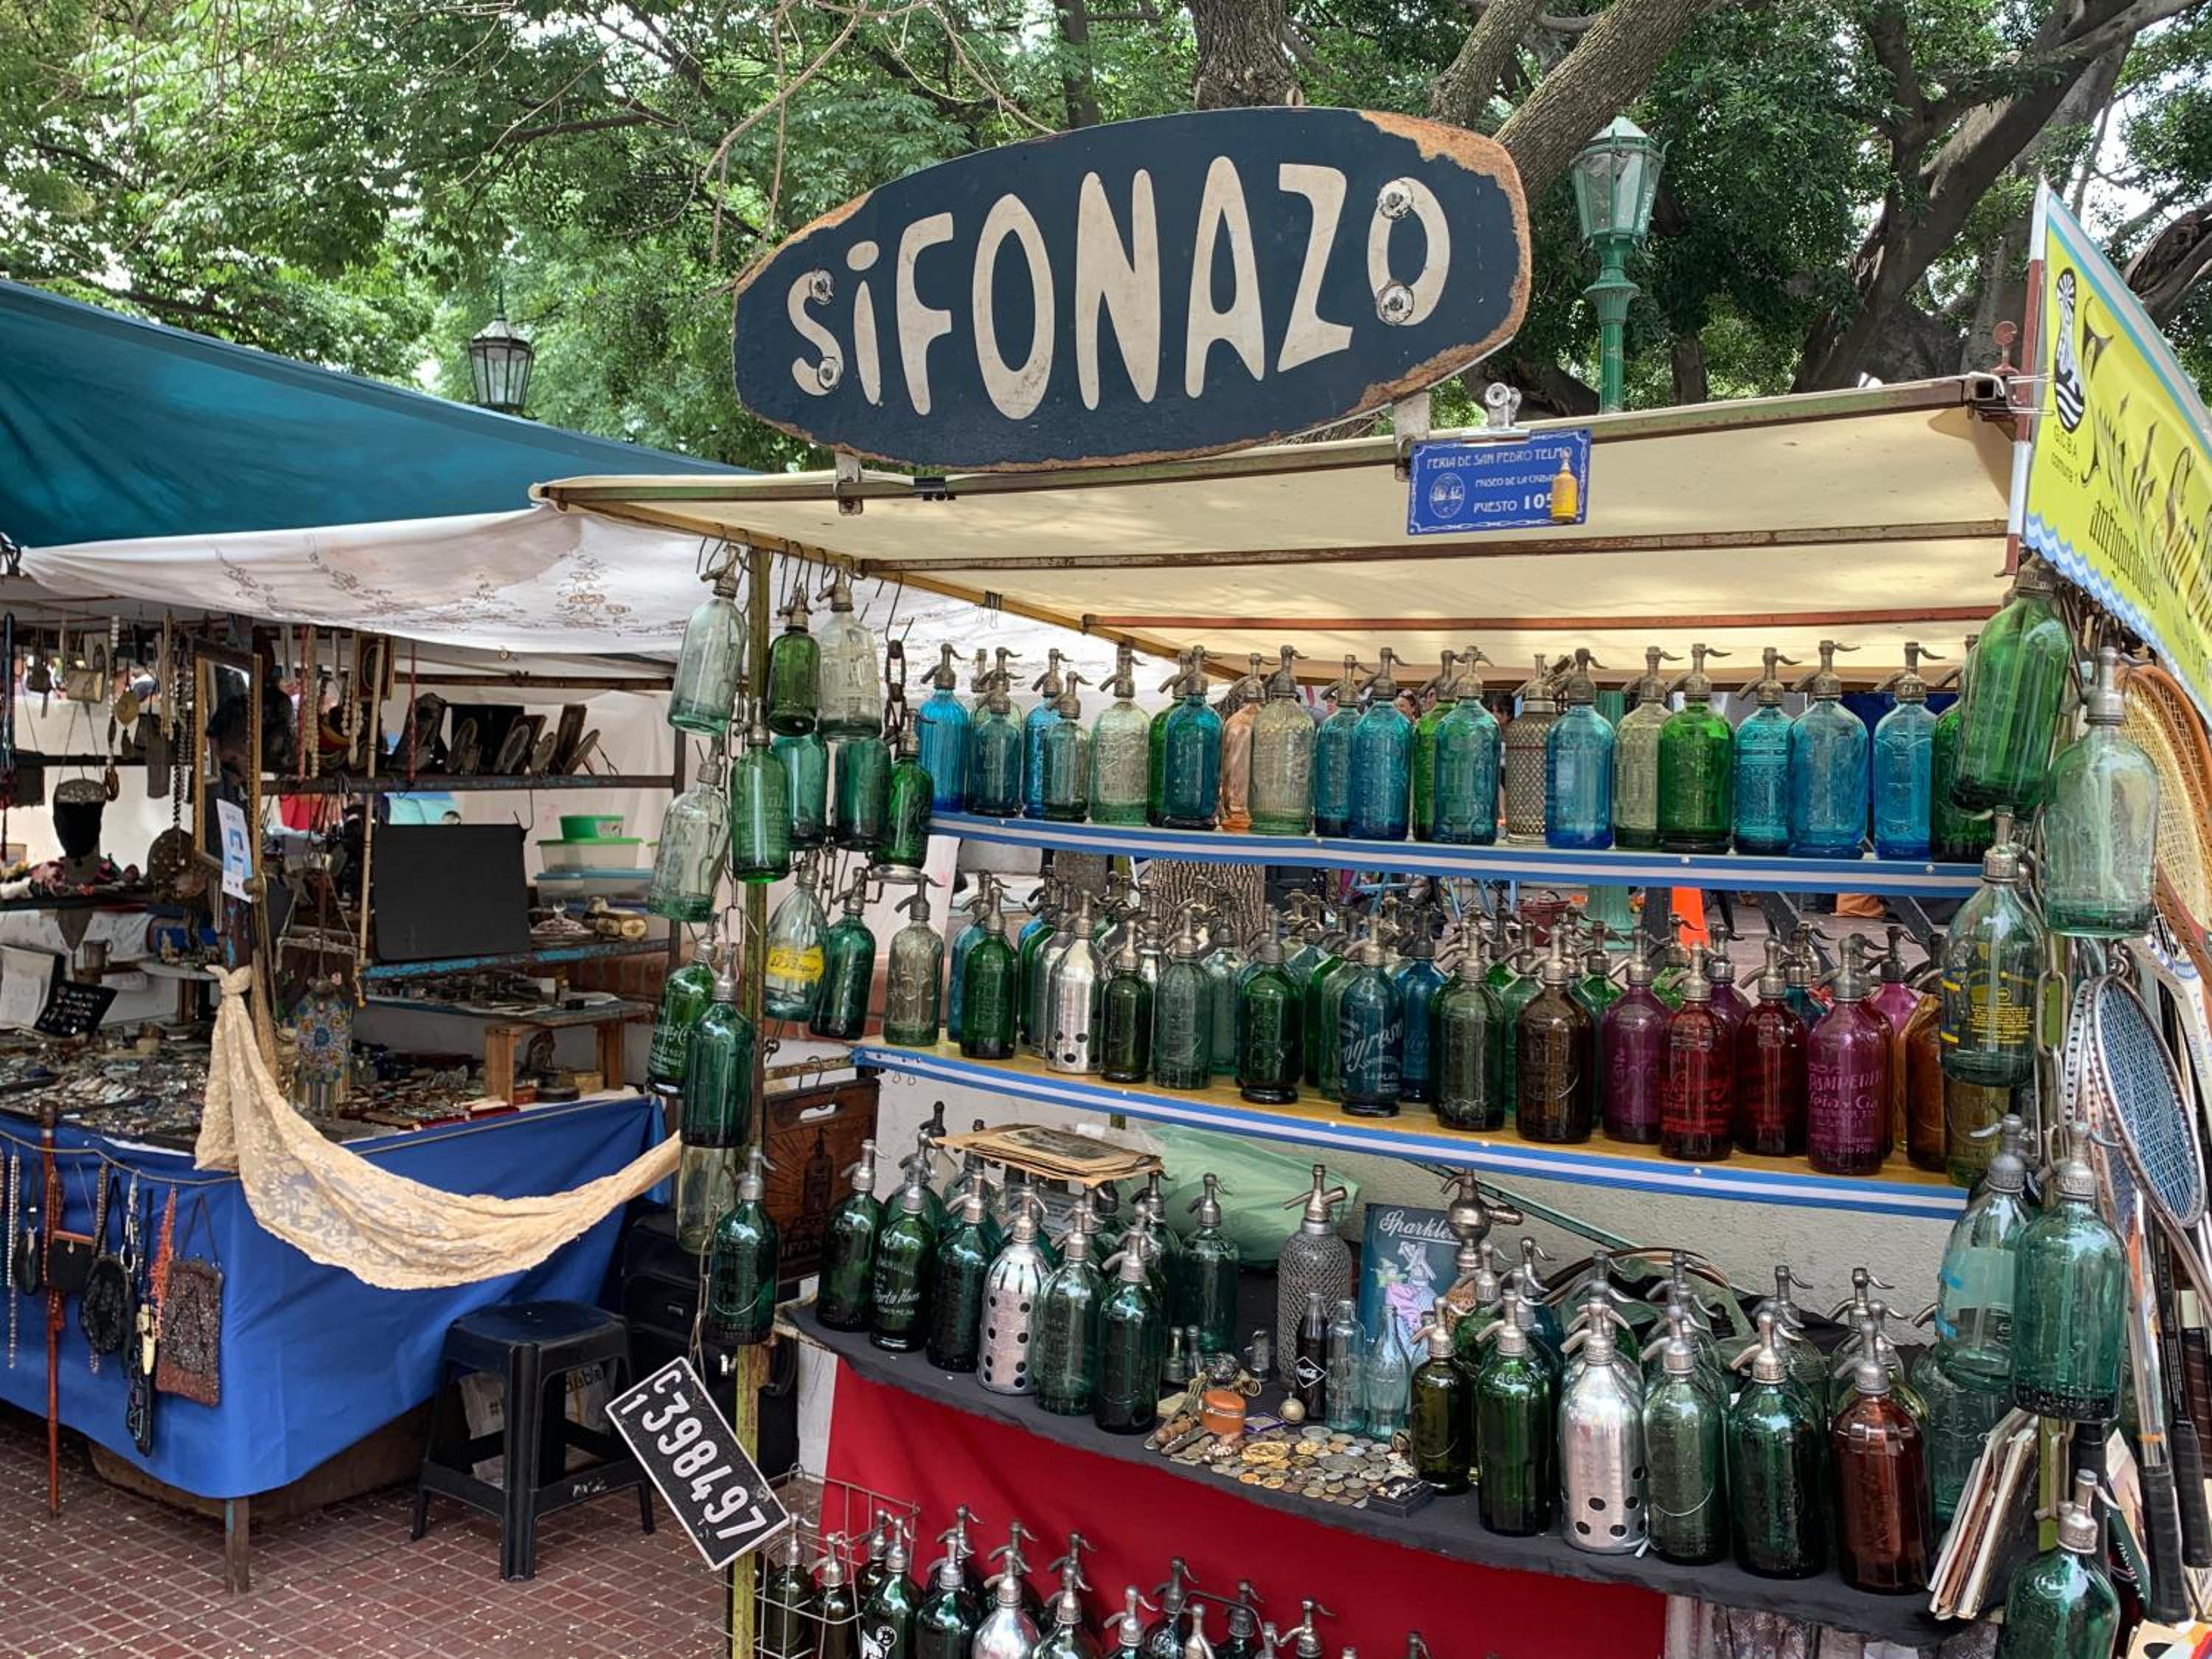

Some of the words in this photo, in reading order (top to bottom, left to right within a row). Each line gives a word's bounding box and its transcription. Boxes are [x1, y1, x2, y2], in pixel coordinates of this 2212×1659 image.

[1427, 456, 1456, 470] FERIA
[1458, 454, 1472, 467] DE
[1473, 453, 1495, 466] SAN
[1496, 449, 1533, 464] PEDRO
[1475, 476, 1505, 488] MUSEO
[1505, 476, 1517, 486] DE
[1473, 499, 1518, 515] PUESTO
